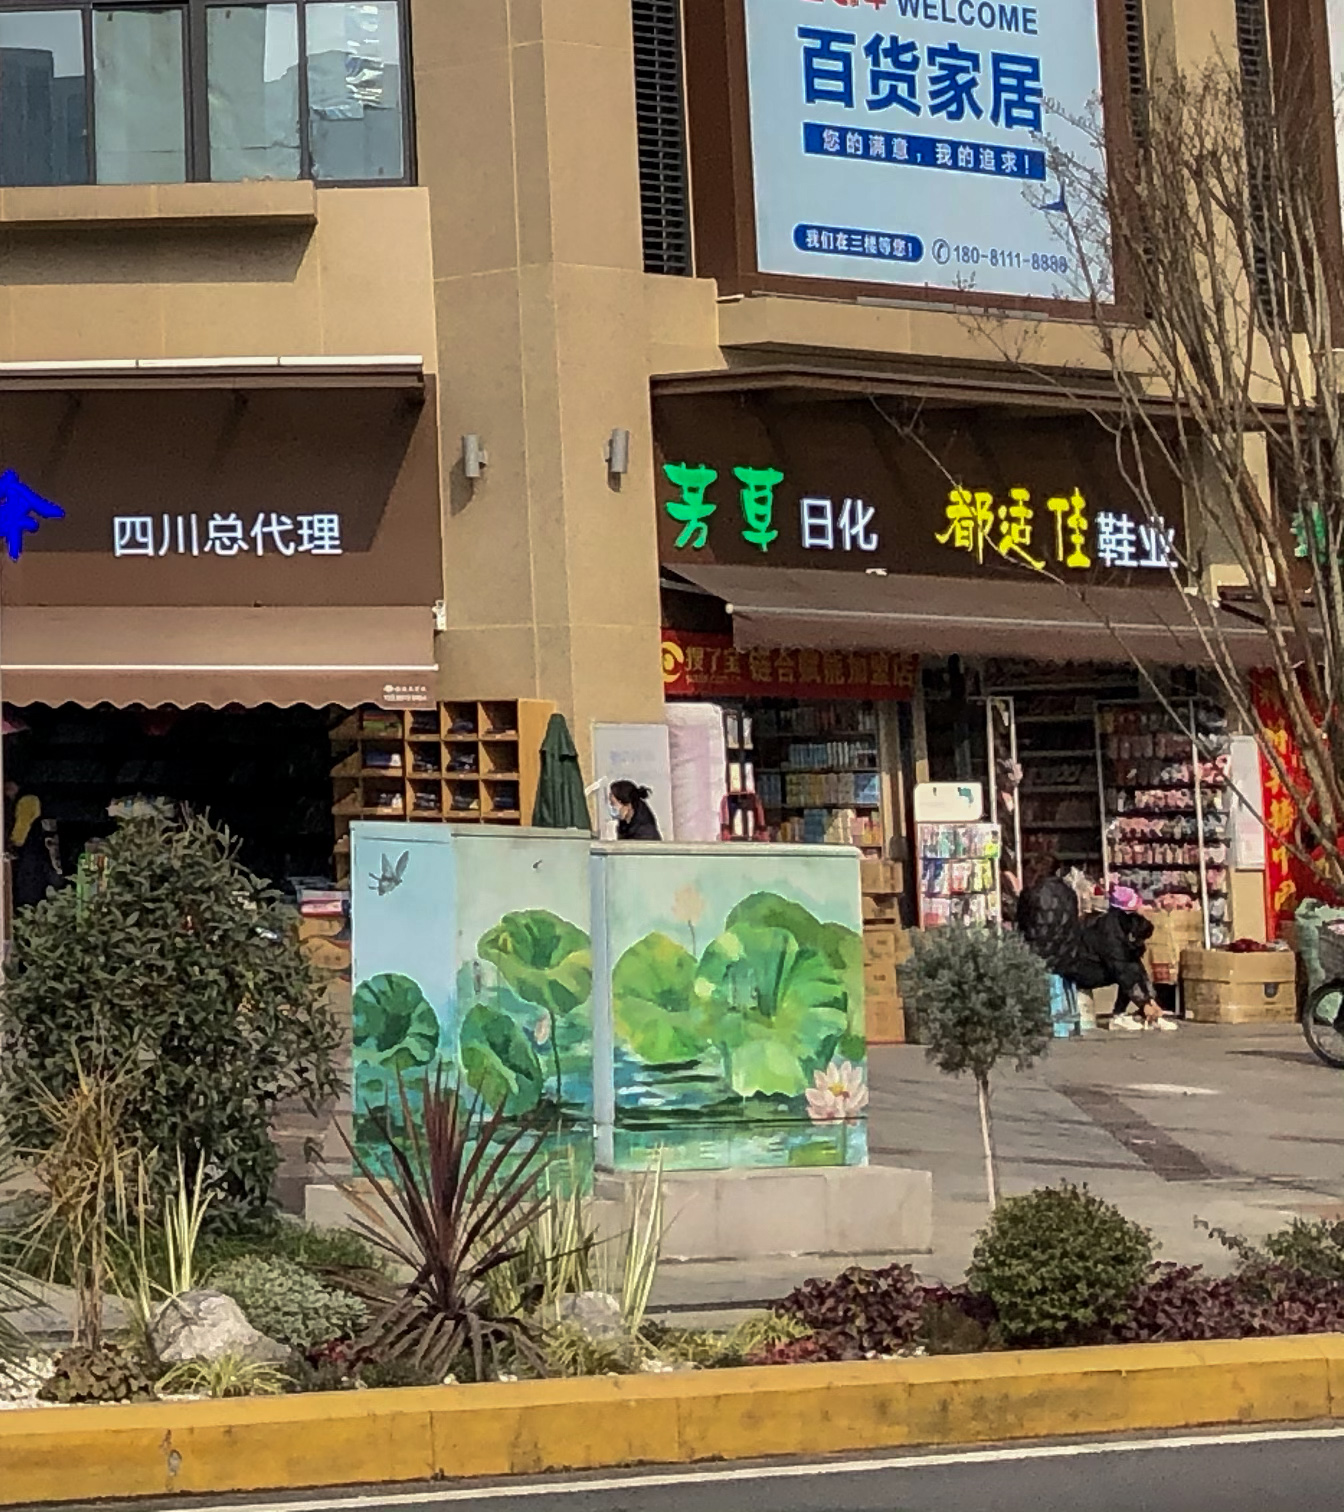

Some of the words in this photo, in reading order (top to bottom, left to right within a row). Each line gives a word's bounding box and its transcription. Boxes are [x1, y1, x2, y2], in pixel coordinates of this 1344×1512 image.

[797, 26, 1044, 132] 百货家居
[113, 513, 343, 557] 四川总代理
[800, 498, 878, 551] 日化
[1095, 511, 1179, 568] 鞋业
